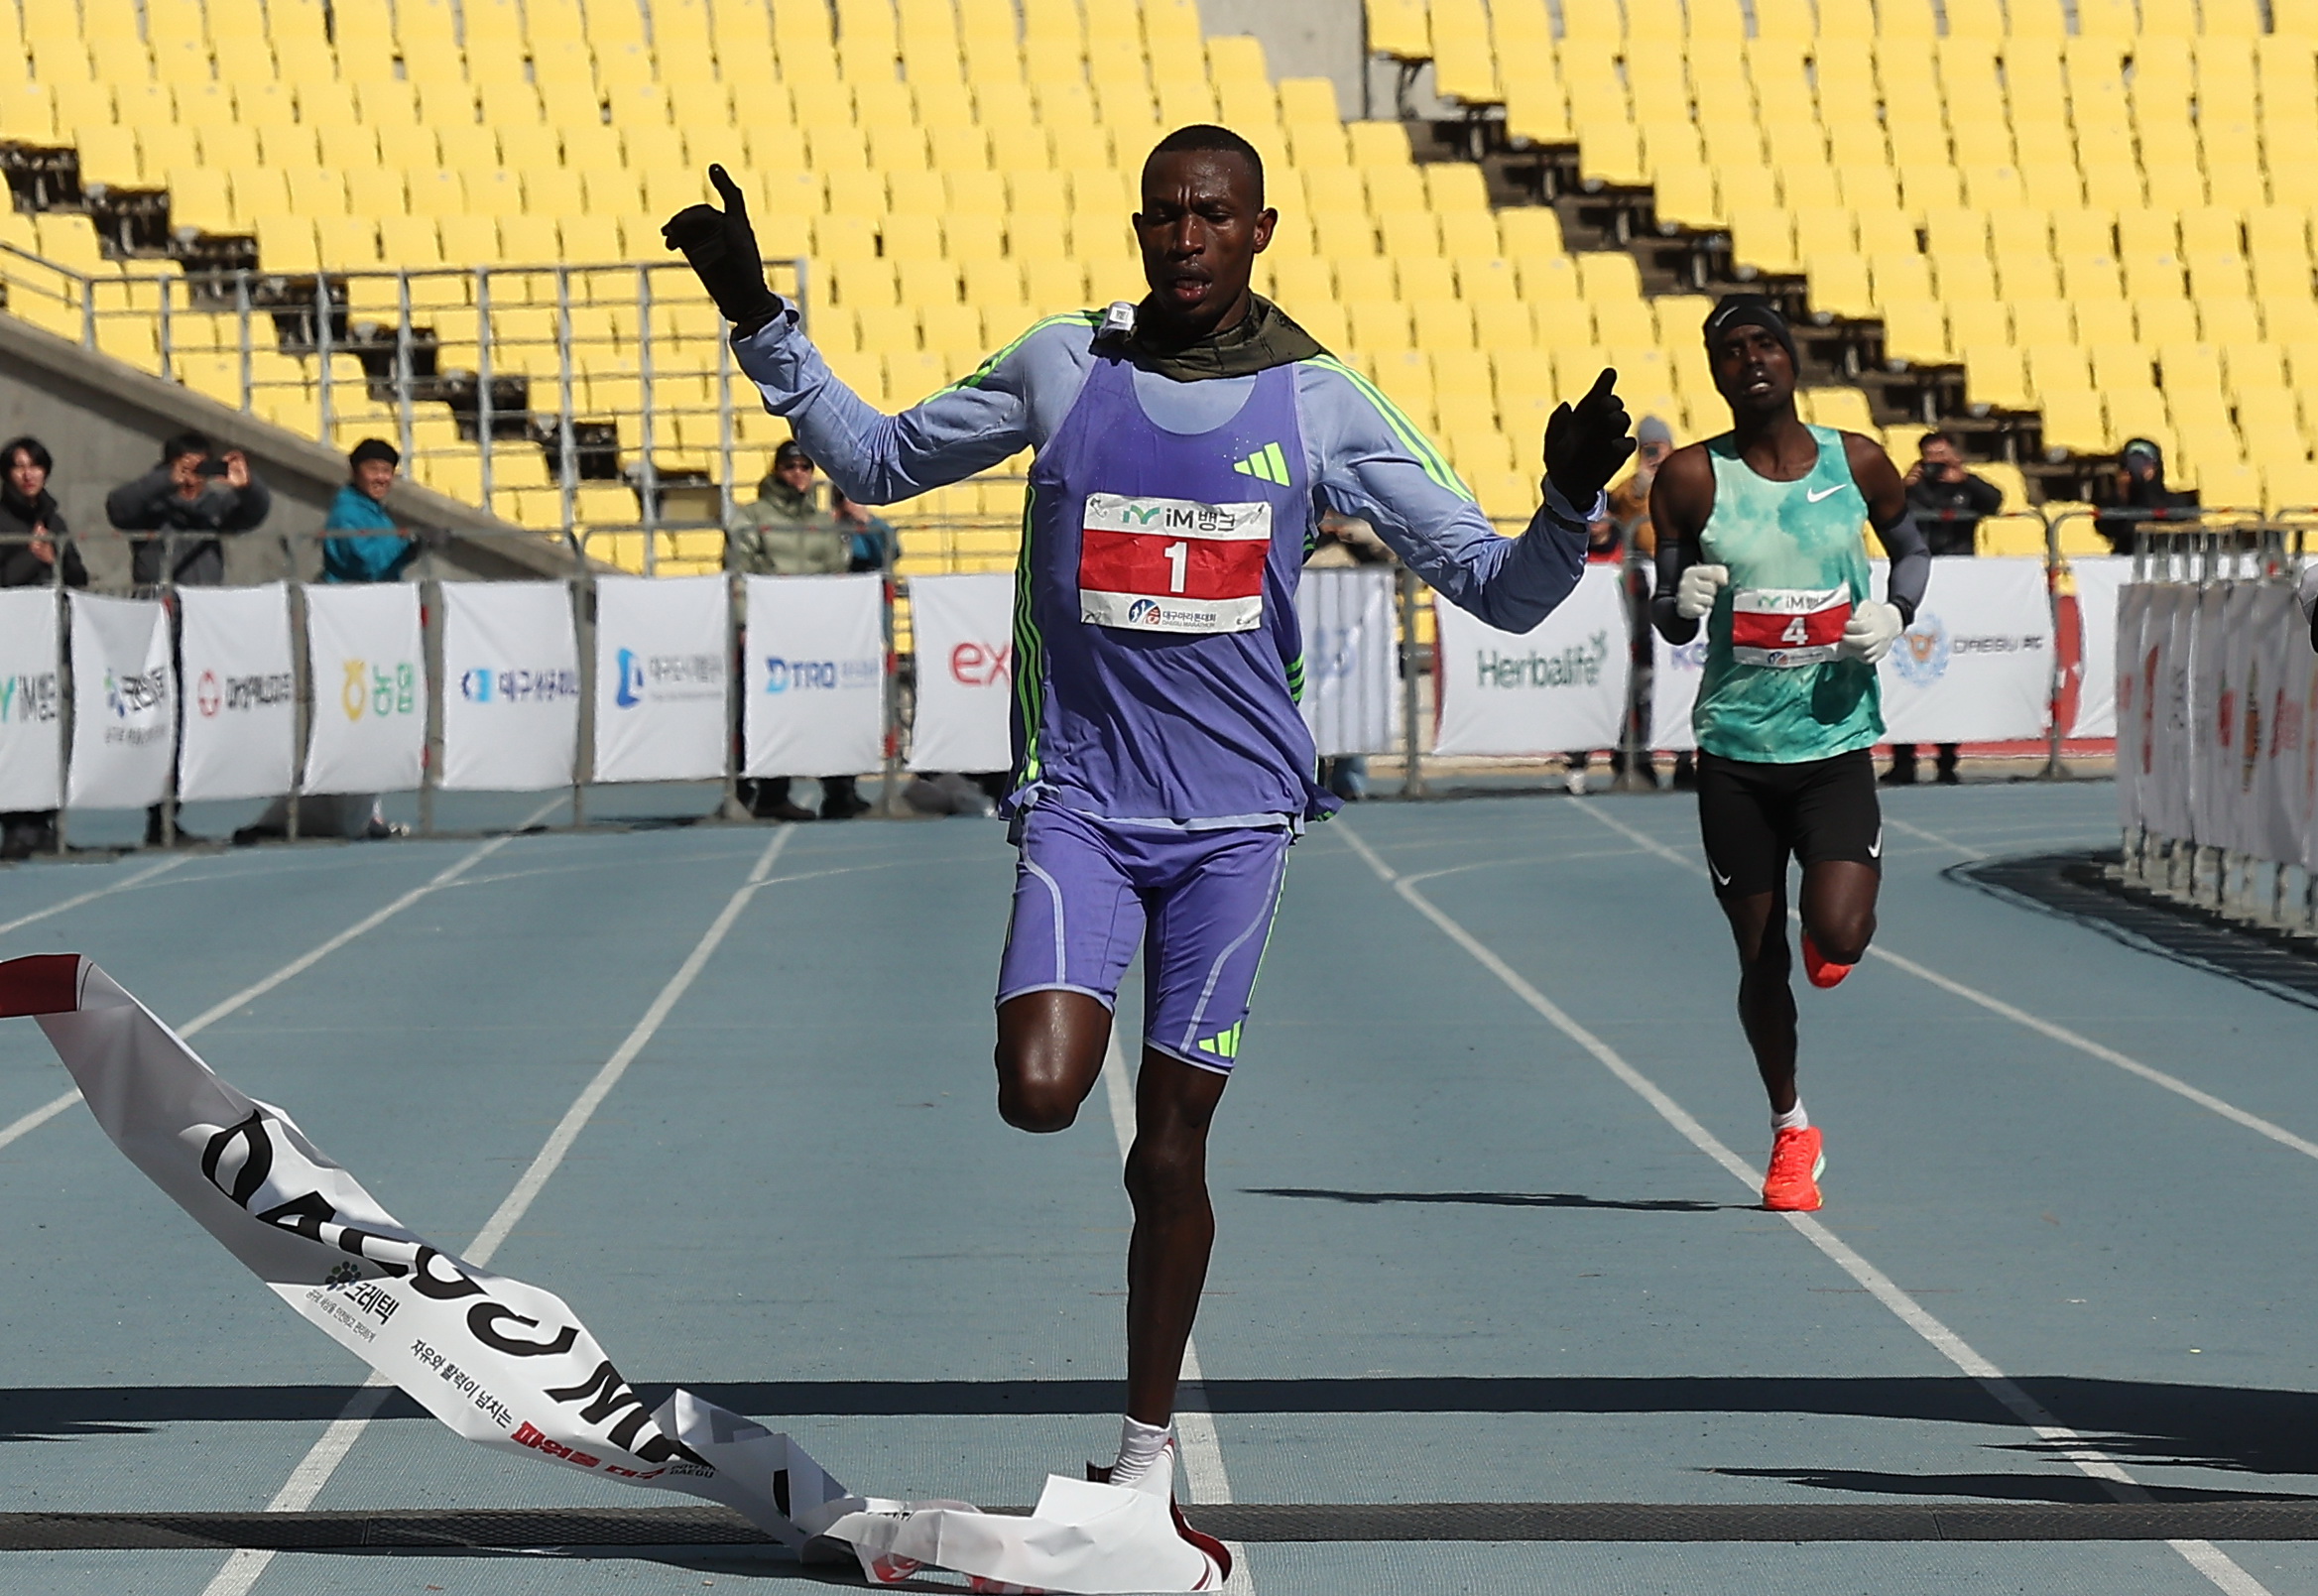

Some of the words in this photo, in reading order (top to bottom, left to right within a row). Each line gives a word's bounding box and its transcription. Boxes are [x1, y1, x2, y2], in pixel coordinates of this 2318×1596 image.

[1165, 508, 1236, 532] iM뱅크
[1164, 542, 1188, 593] 1
[1162, 611, 1216, 622] 대구마라톤대회
[1781, 617, 1808, 645] 4
[1476, 650, 1600, 687] Herbalife
[371, 663, 414, 716] 농협
[343, 1282, 400, 1326] 크레텍
[410, 1338, 446, 1372] 자유와
[440, 1362, 478, 1401] 활력이
[474, 1391, 515, 1428] 넘치는
